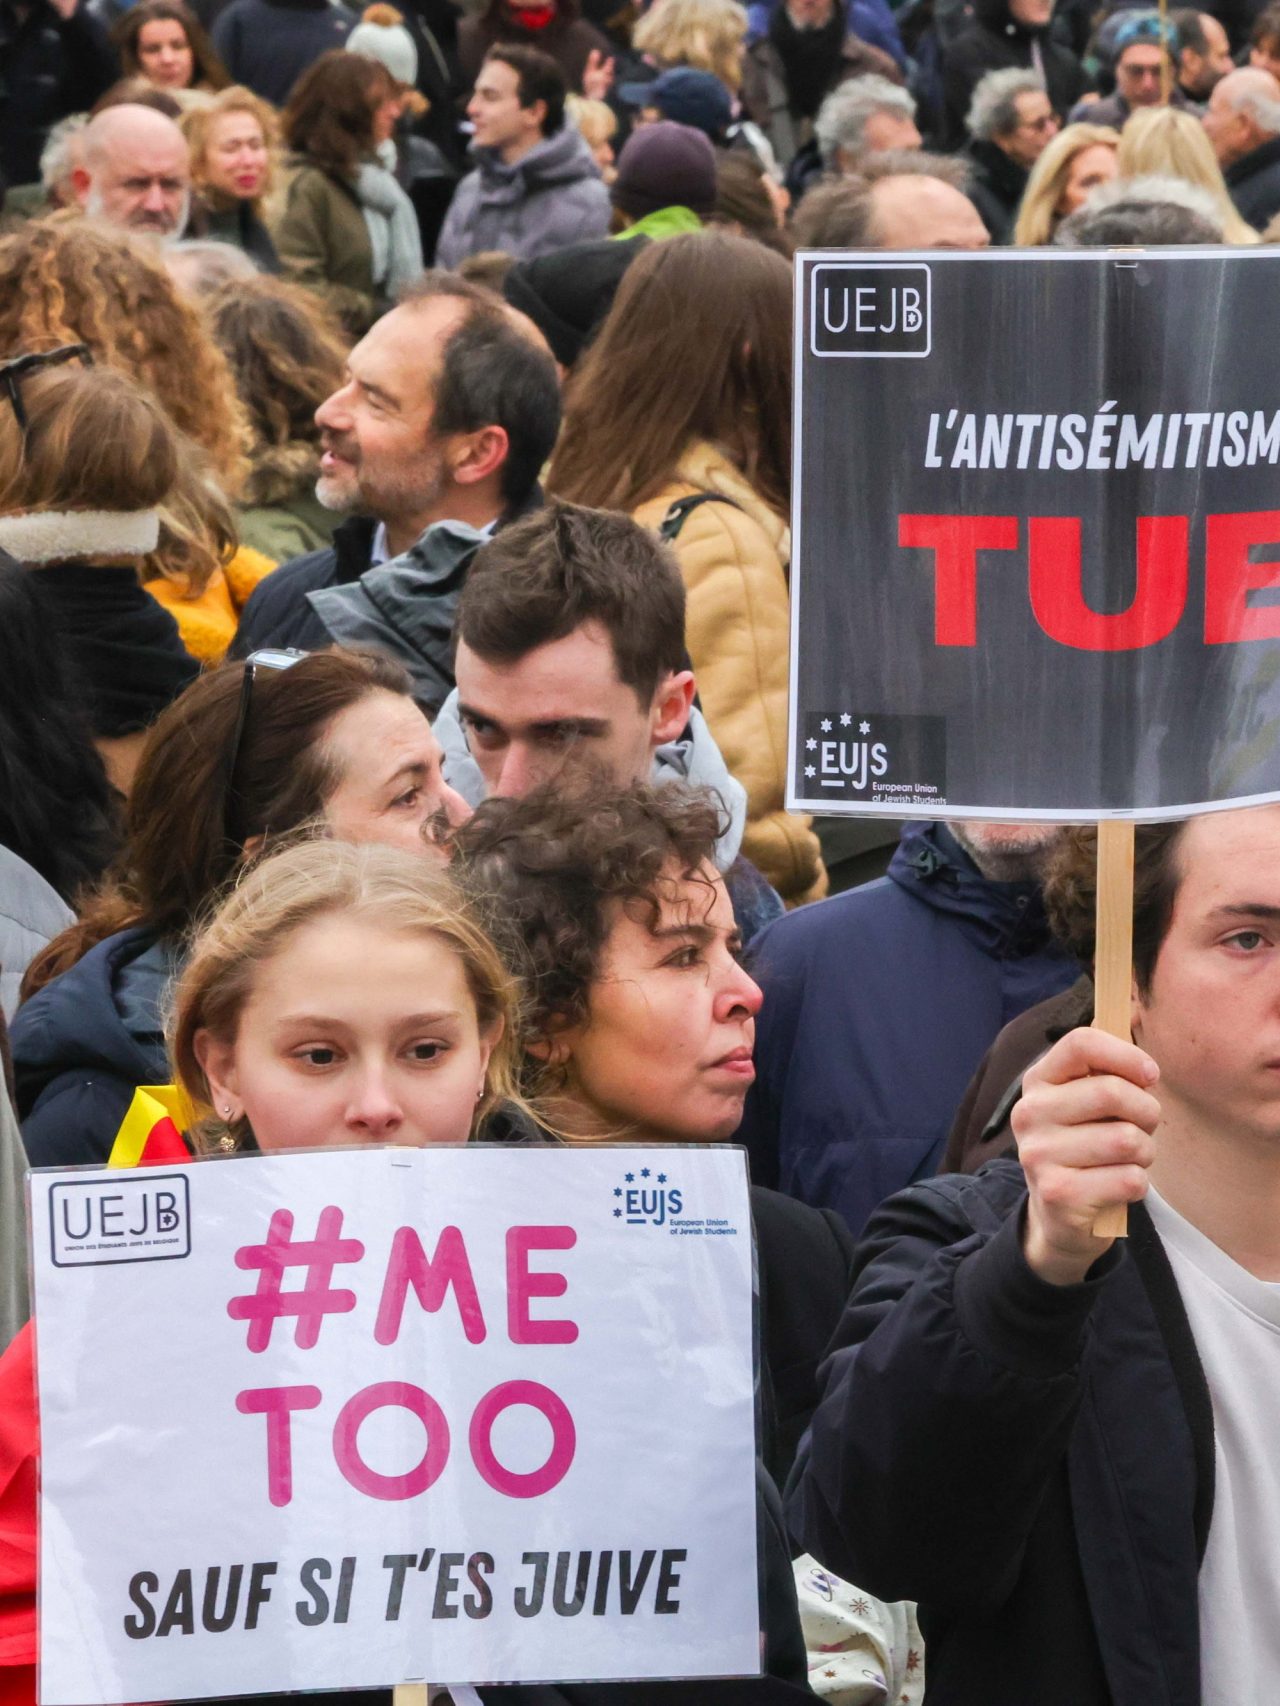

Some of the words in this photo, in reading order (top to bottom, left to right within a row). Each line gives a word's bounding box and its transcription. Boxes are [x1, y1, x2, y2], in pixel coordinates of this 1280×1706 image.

[823, 287, 923, 333] UEJB
[820, 741, 888, 790] EUJS
[872, 782, 913, 793] European
[914, 783, 938, 793] Union
[63, 1191, 180, 1240] UEJB
[626, 1189, 683, 1226] EUJS
[669, 1219, 704, 1227] European
[706, 1218, 728, 1226] Union
[227, 1205, 579, 1353] #ME
[235, 1379, 577, 1507] TOO
[124, 1561, 277, 1640] SAUF
[295, 1556, 356, 1626] SI
[382, 1548, 495, 1619] T'ES
[514, 1548, 687, 1618] JUIVE
